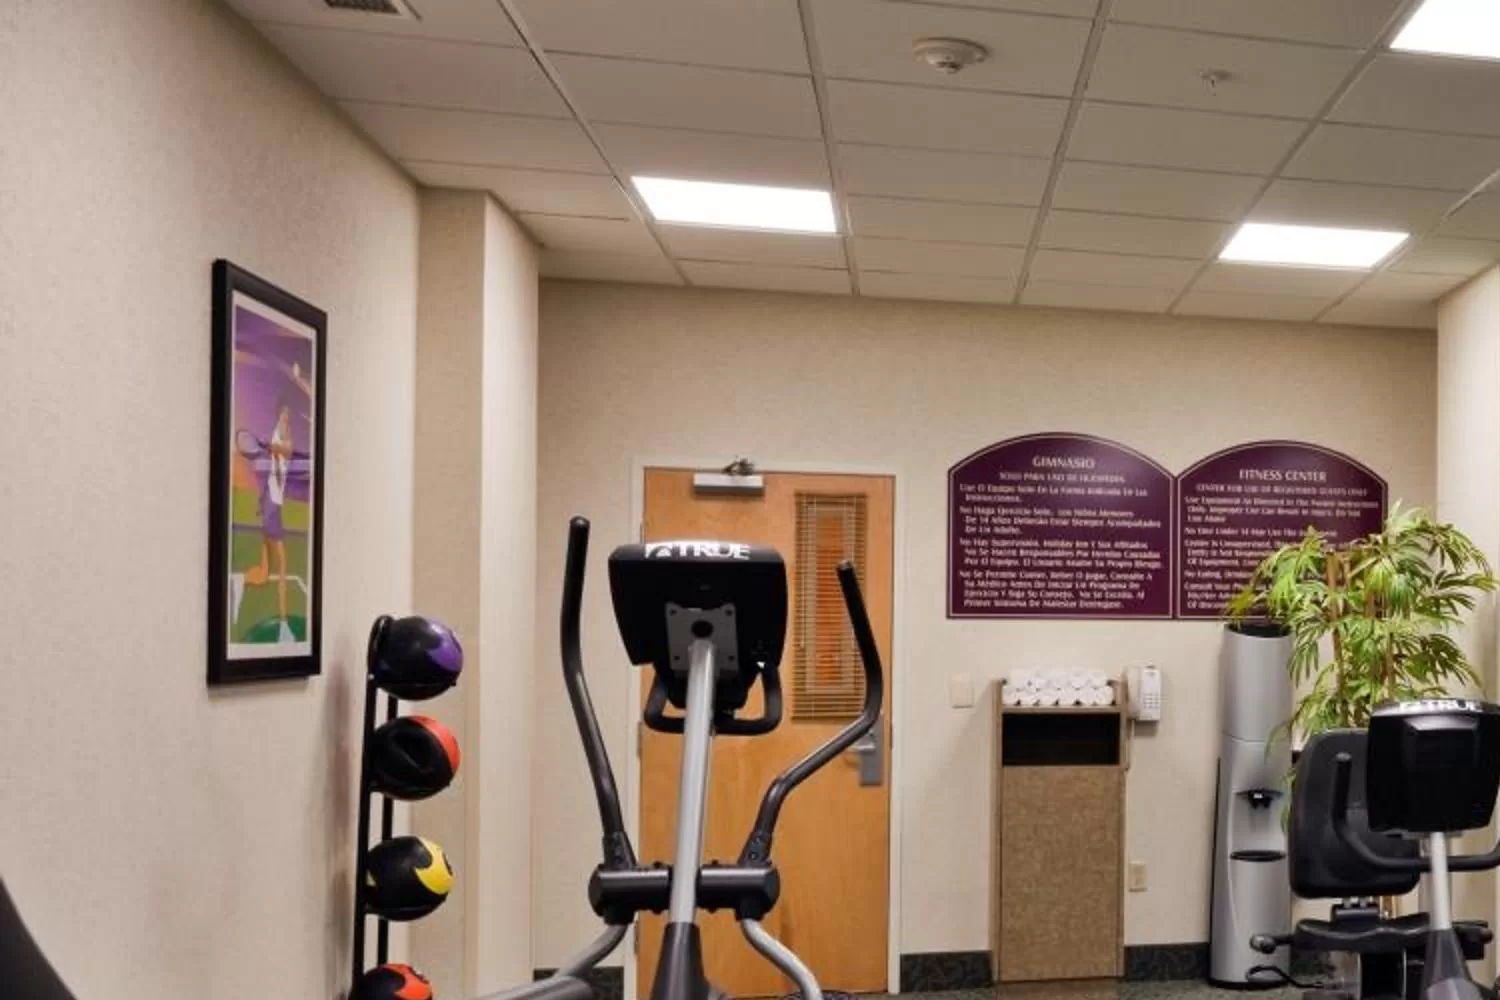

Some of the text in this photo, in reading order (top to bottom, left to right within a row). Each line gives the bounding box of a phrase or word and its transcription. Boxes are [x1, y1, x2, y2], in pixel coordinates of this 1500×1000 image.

[1033, 456, 1096, 469] GIMNASIO
[1239, 469, 1328, 482] FITNESS CENTER
[674, 542, 751, 560] TRUE
